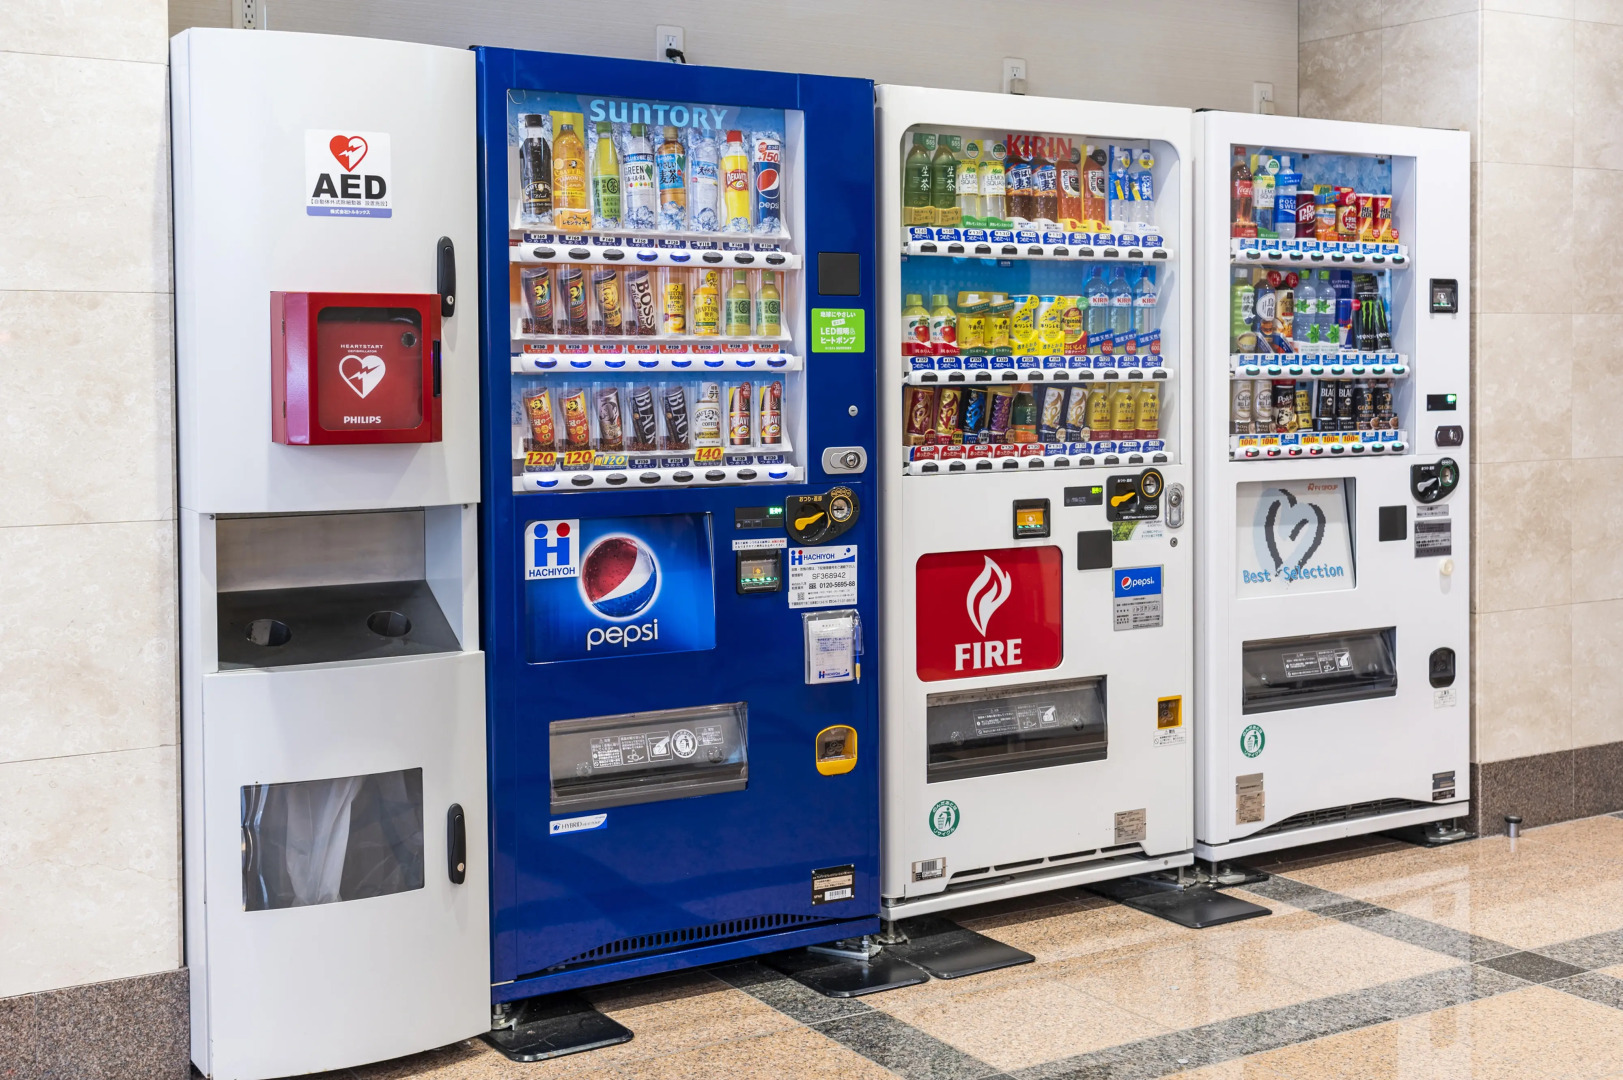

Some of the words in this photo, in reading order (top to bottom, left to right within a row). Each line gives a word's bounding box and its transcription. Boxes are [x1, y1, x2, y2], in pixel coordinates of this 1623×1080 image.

[590, 99, 728, 130] SUNTORY
[1006, 134, 1073, 159] KIRIN
[312, 173, 387, 200] AED
[659, 170, 679, 185] 麦茶
[920, 165, 930, 192] 生茶
[946, 165, 956, 192] 生茶
[635, 279, 655, 327] BOSS
[820, 336, 856, 344] ヒートポンプ
[343, 416, 382, 424] PHILIPS
[634, 394, 657, 444] BLACK
[666, 395, 689, 444] BLACK
[803, 553, 835, 561] HACHIYOH
[529, 567, 576, 578] HACHIYOH
[1132, 576, 1153, 588] pepsi
[1243, 569, 1272, 584] Best
[1283, 563, 1345, 581] Selection
[586, 618, 659, 651] pepsi
[954, 638, 1023, 671] FIRE
[561, 821, 582, 829] HYBRID
